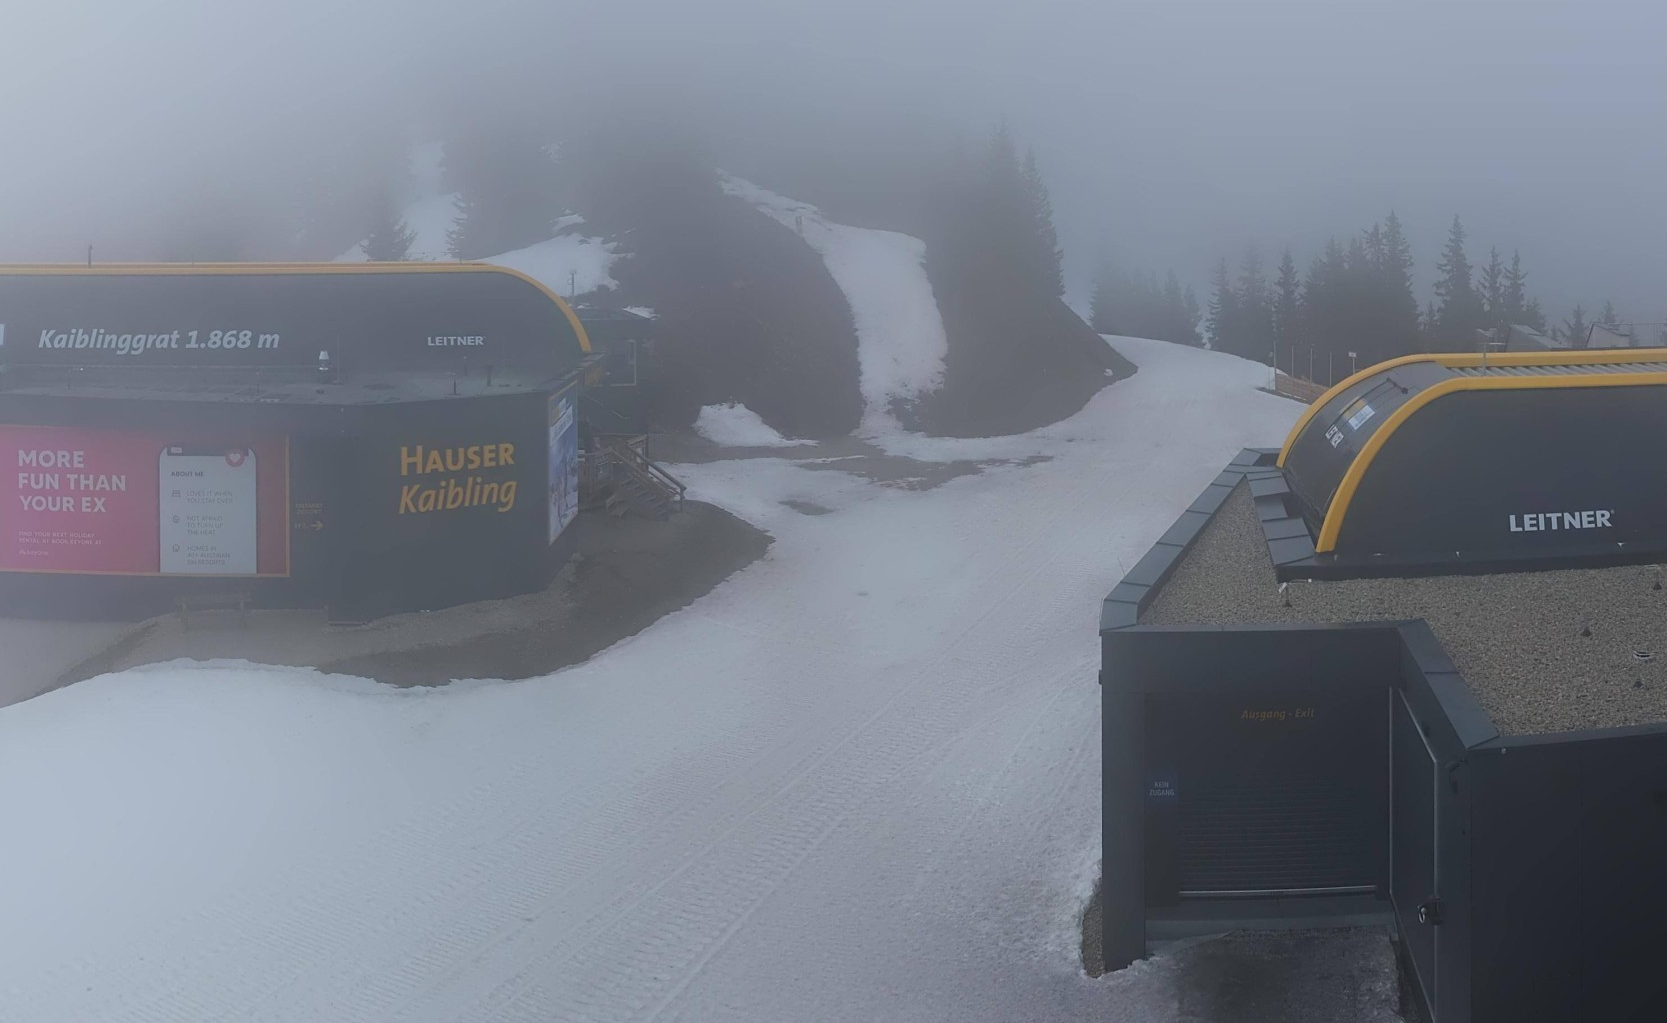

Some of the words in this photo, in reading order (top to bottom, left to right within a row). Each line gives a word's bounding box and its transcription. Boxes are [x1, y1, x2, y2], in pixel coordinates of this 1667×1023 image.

[38, 328, 179, 356] Kaiblinggrat
[184, 329, 251, 349] 1.868
[257, 333, 281, 349] m
[427, 335, 484, 346] LEITNER
[18, 449, 85, 468] MORE
[400, 443, 515, 476] HAUSER
[18, 473, 60, 490] FUN
[66, 474, 126, 491] THAN
[20, 495, 75, 512] YOUR
[81, 497, 107, 513] EX
[398, 477, 518, 515] Kaibling
[1509, 510, 1613, 532] LEITNER
[1240, 709, 1286, 722] Ausgang
[1294, 707, 1316, 718] Exit
